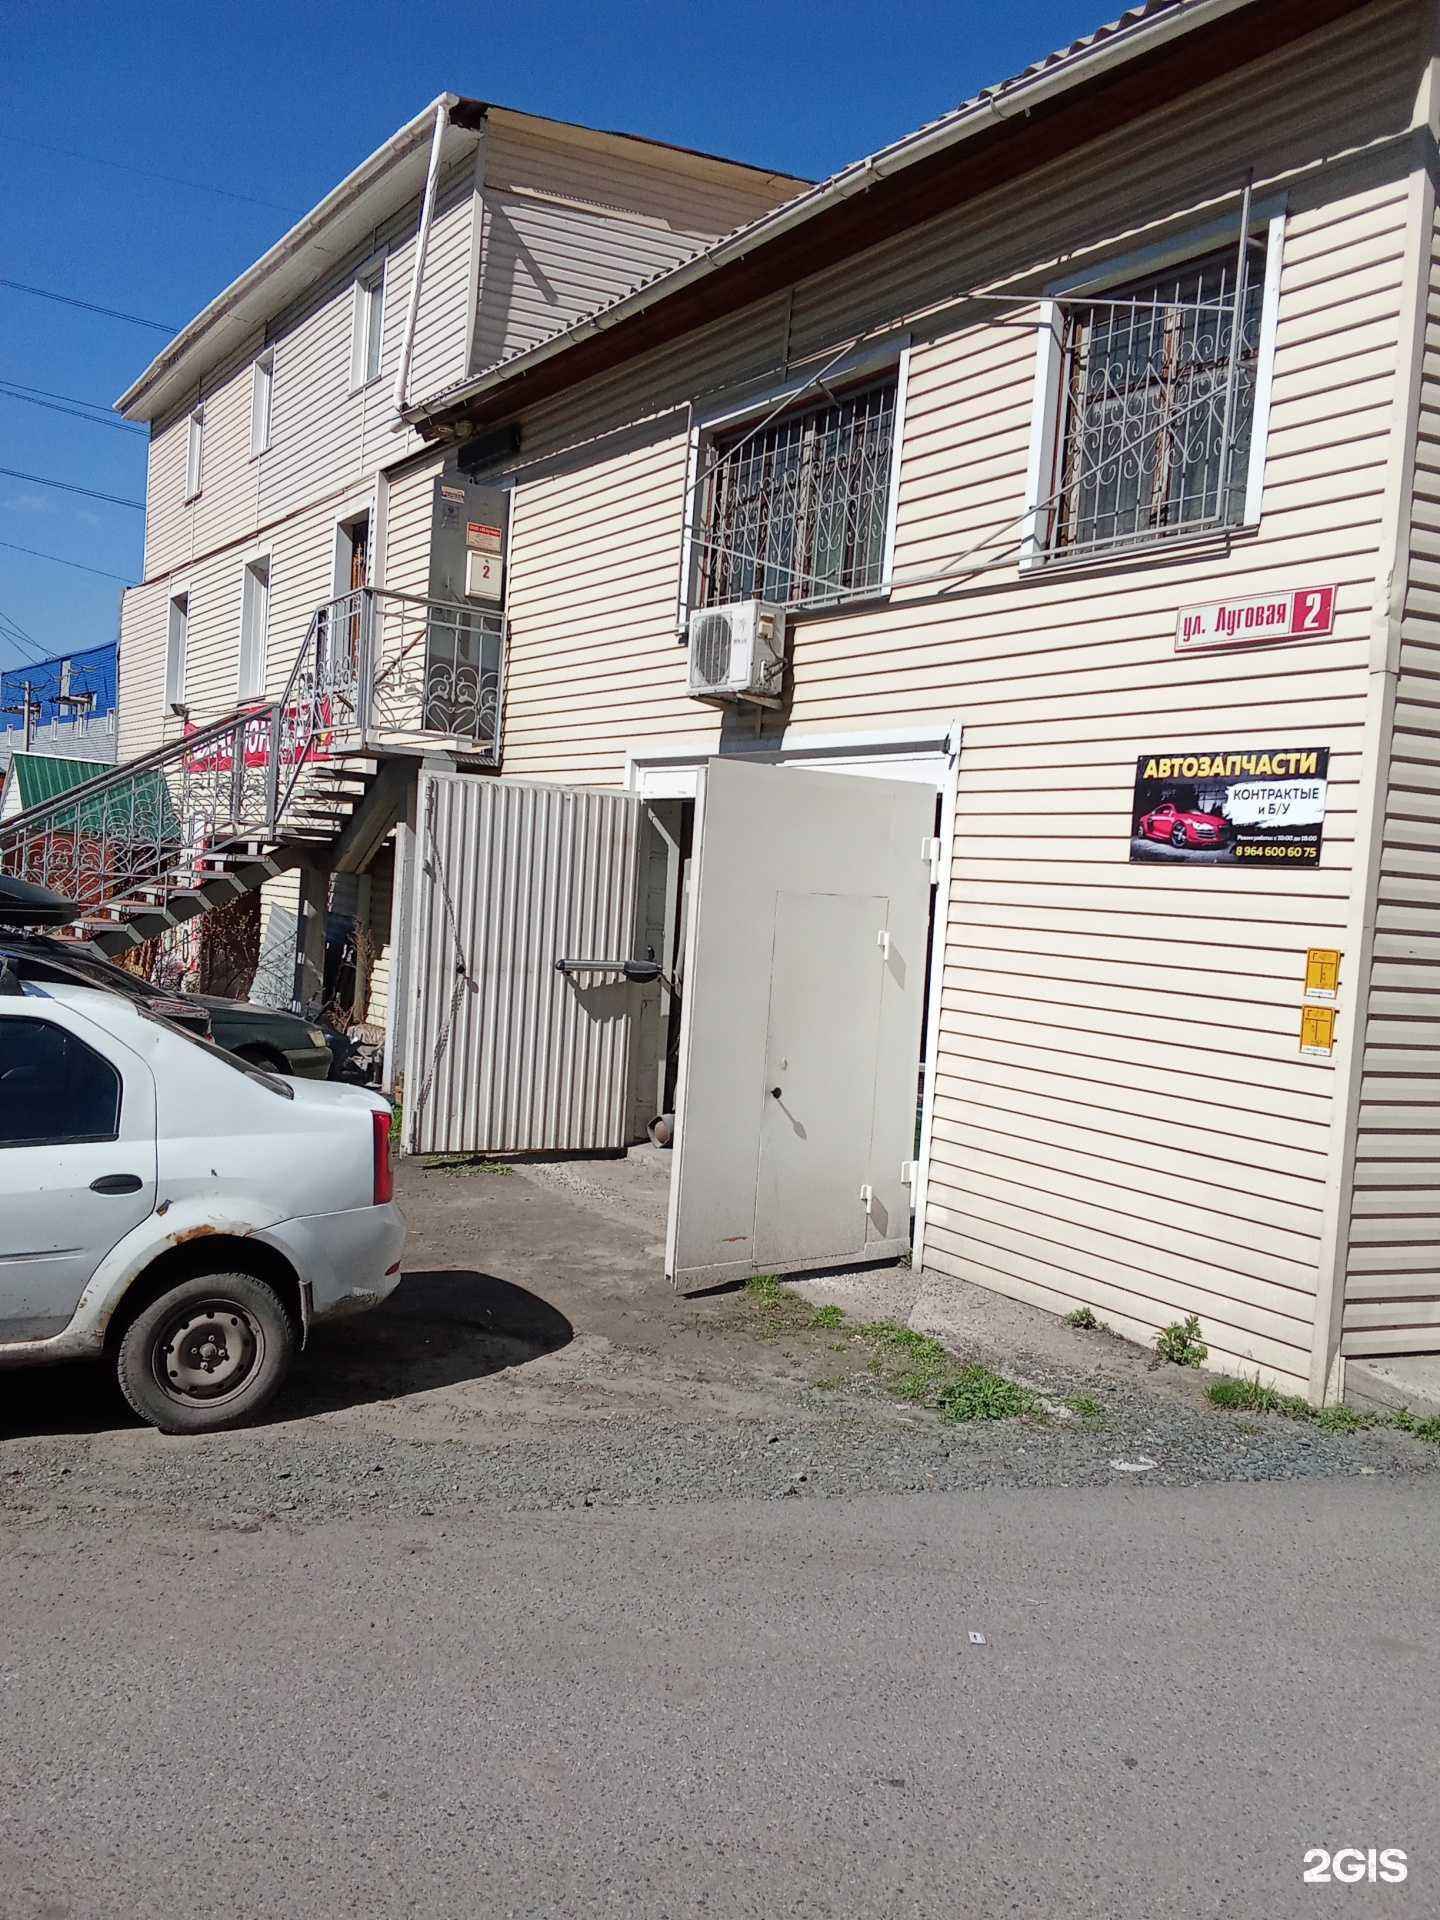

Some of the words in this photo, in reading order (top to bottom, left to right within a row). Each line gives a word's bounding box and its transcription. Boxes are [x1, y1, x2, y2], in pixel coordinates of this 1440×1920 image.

[482, 565, 491, 579] 2
[1183, 615, 1206, 642] ул.
[1214, 603, 1287, 636] Луговая
[1303, 592, 1322, 629] 2
[1143, 752, 1318, 779] АВТОЗАПЧАСТИ
[1233, 787, 1320, 801] КОНТРАКТЫЕ
[1268, 803, 1291, 815] Б/У
[1235, 846, 1243, 856] 8
[1244, 846, 1263, 856] 964
[1264, 846, 1286, 857] 600
[1287, 846, 1302, 857] 60
[1303, 847, 1317, 858] 75
